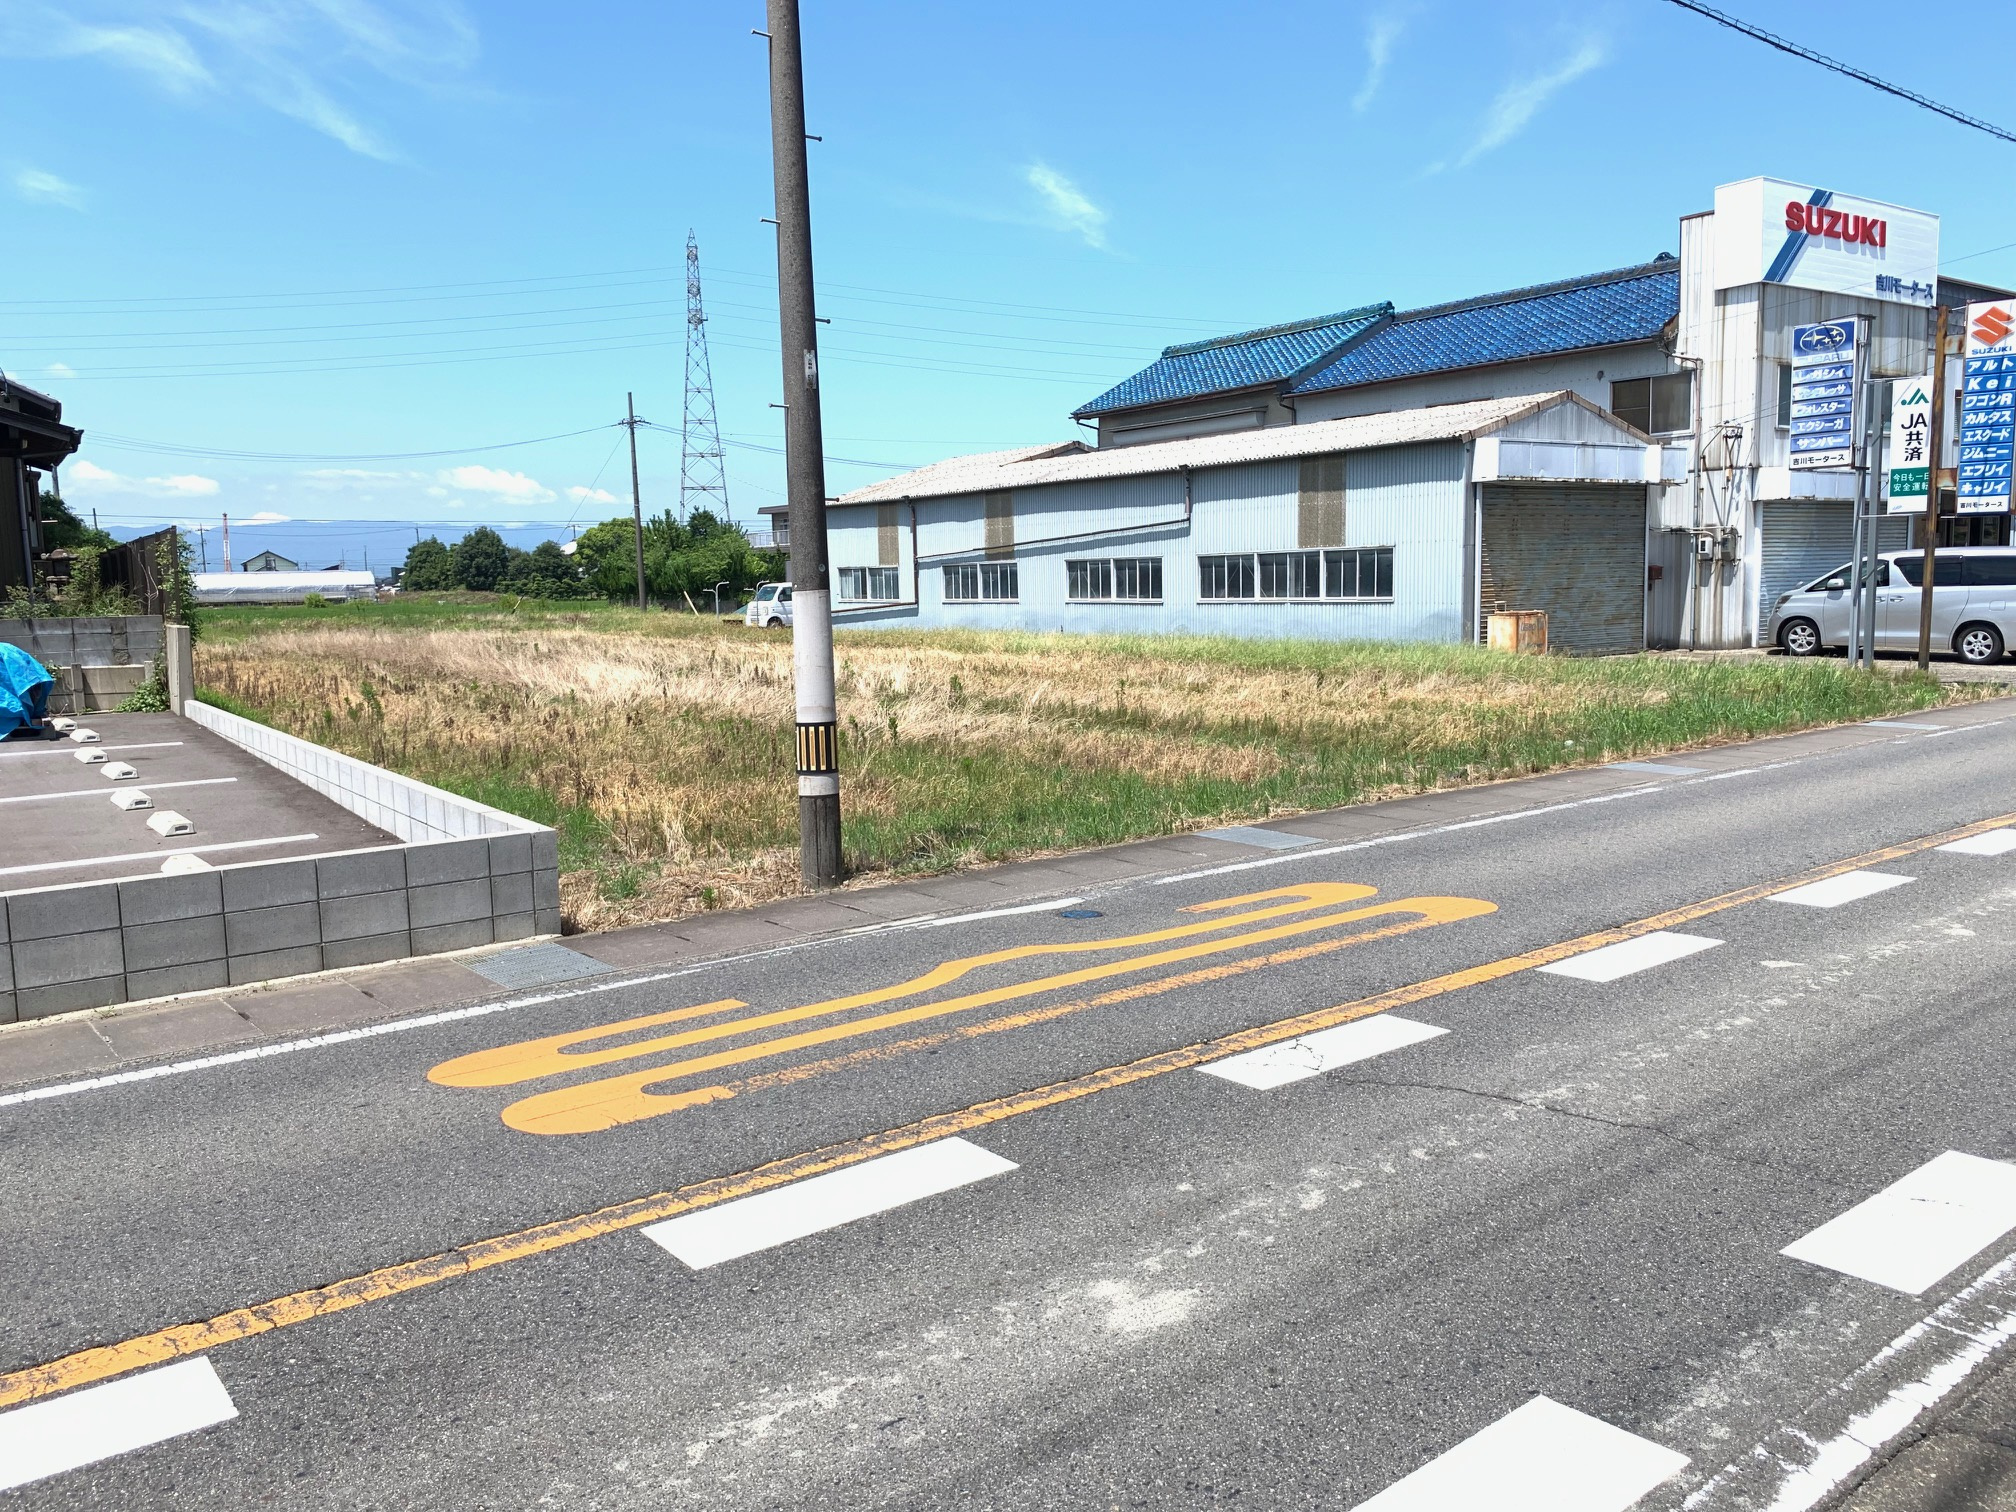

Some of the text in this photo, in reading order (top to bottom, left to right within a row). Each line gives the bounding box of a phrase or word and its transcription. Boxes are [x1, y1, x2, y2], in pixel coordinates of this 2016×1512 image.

[1785, 201, 1887, 248] SUZUKI
[1971, 345, 2013, 356] SUZUKI
[1967, 357, 2014, 373] アルト
[1967, 375, 2013, 391] Kei
[1797, 417, 1845, 432] エクシーガ
[1964, 410, 2012, 425] カルタス
[1796, 436, 1845, 449] サンバー
[1963, 428, 2011, 442] エスクード
[1962, 446, 2010, 460] ジムニー
[1960, 480, 2007, 495] キャリイ
